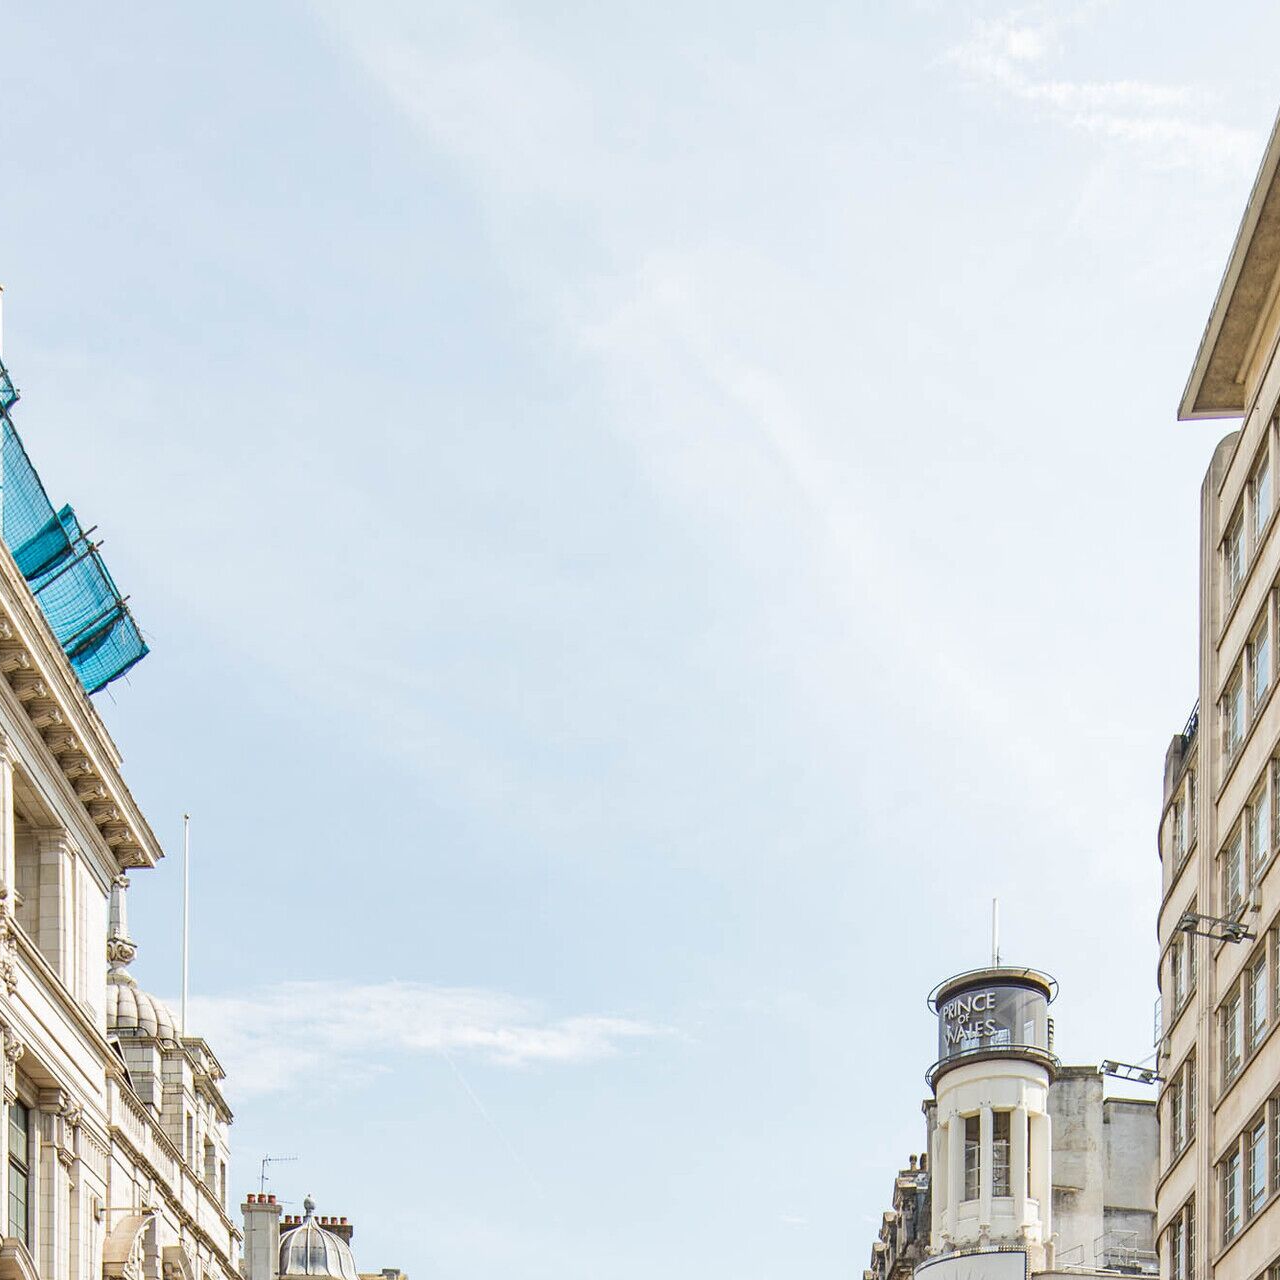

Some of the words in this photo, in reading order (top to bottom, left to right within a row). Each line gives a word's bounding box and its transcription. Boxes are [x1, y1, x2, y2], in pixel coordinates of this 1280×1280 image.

[943, 992, 997, 1021] PRINCE
[957, 1013, 970, 1024] OF
[944, 1019, 998, 1046] WALES
